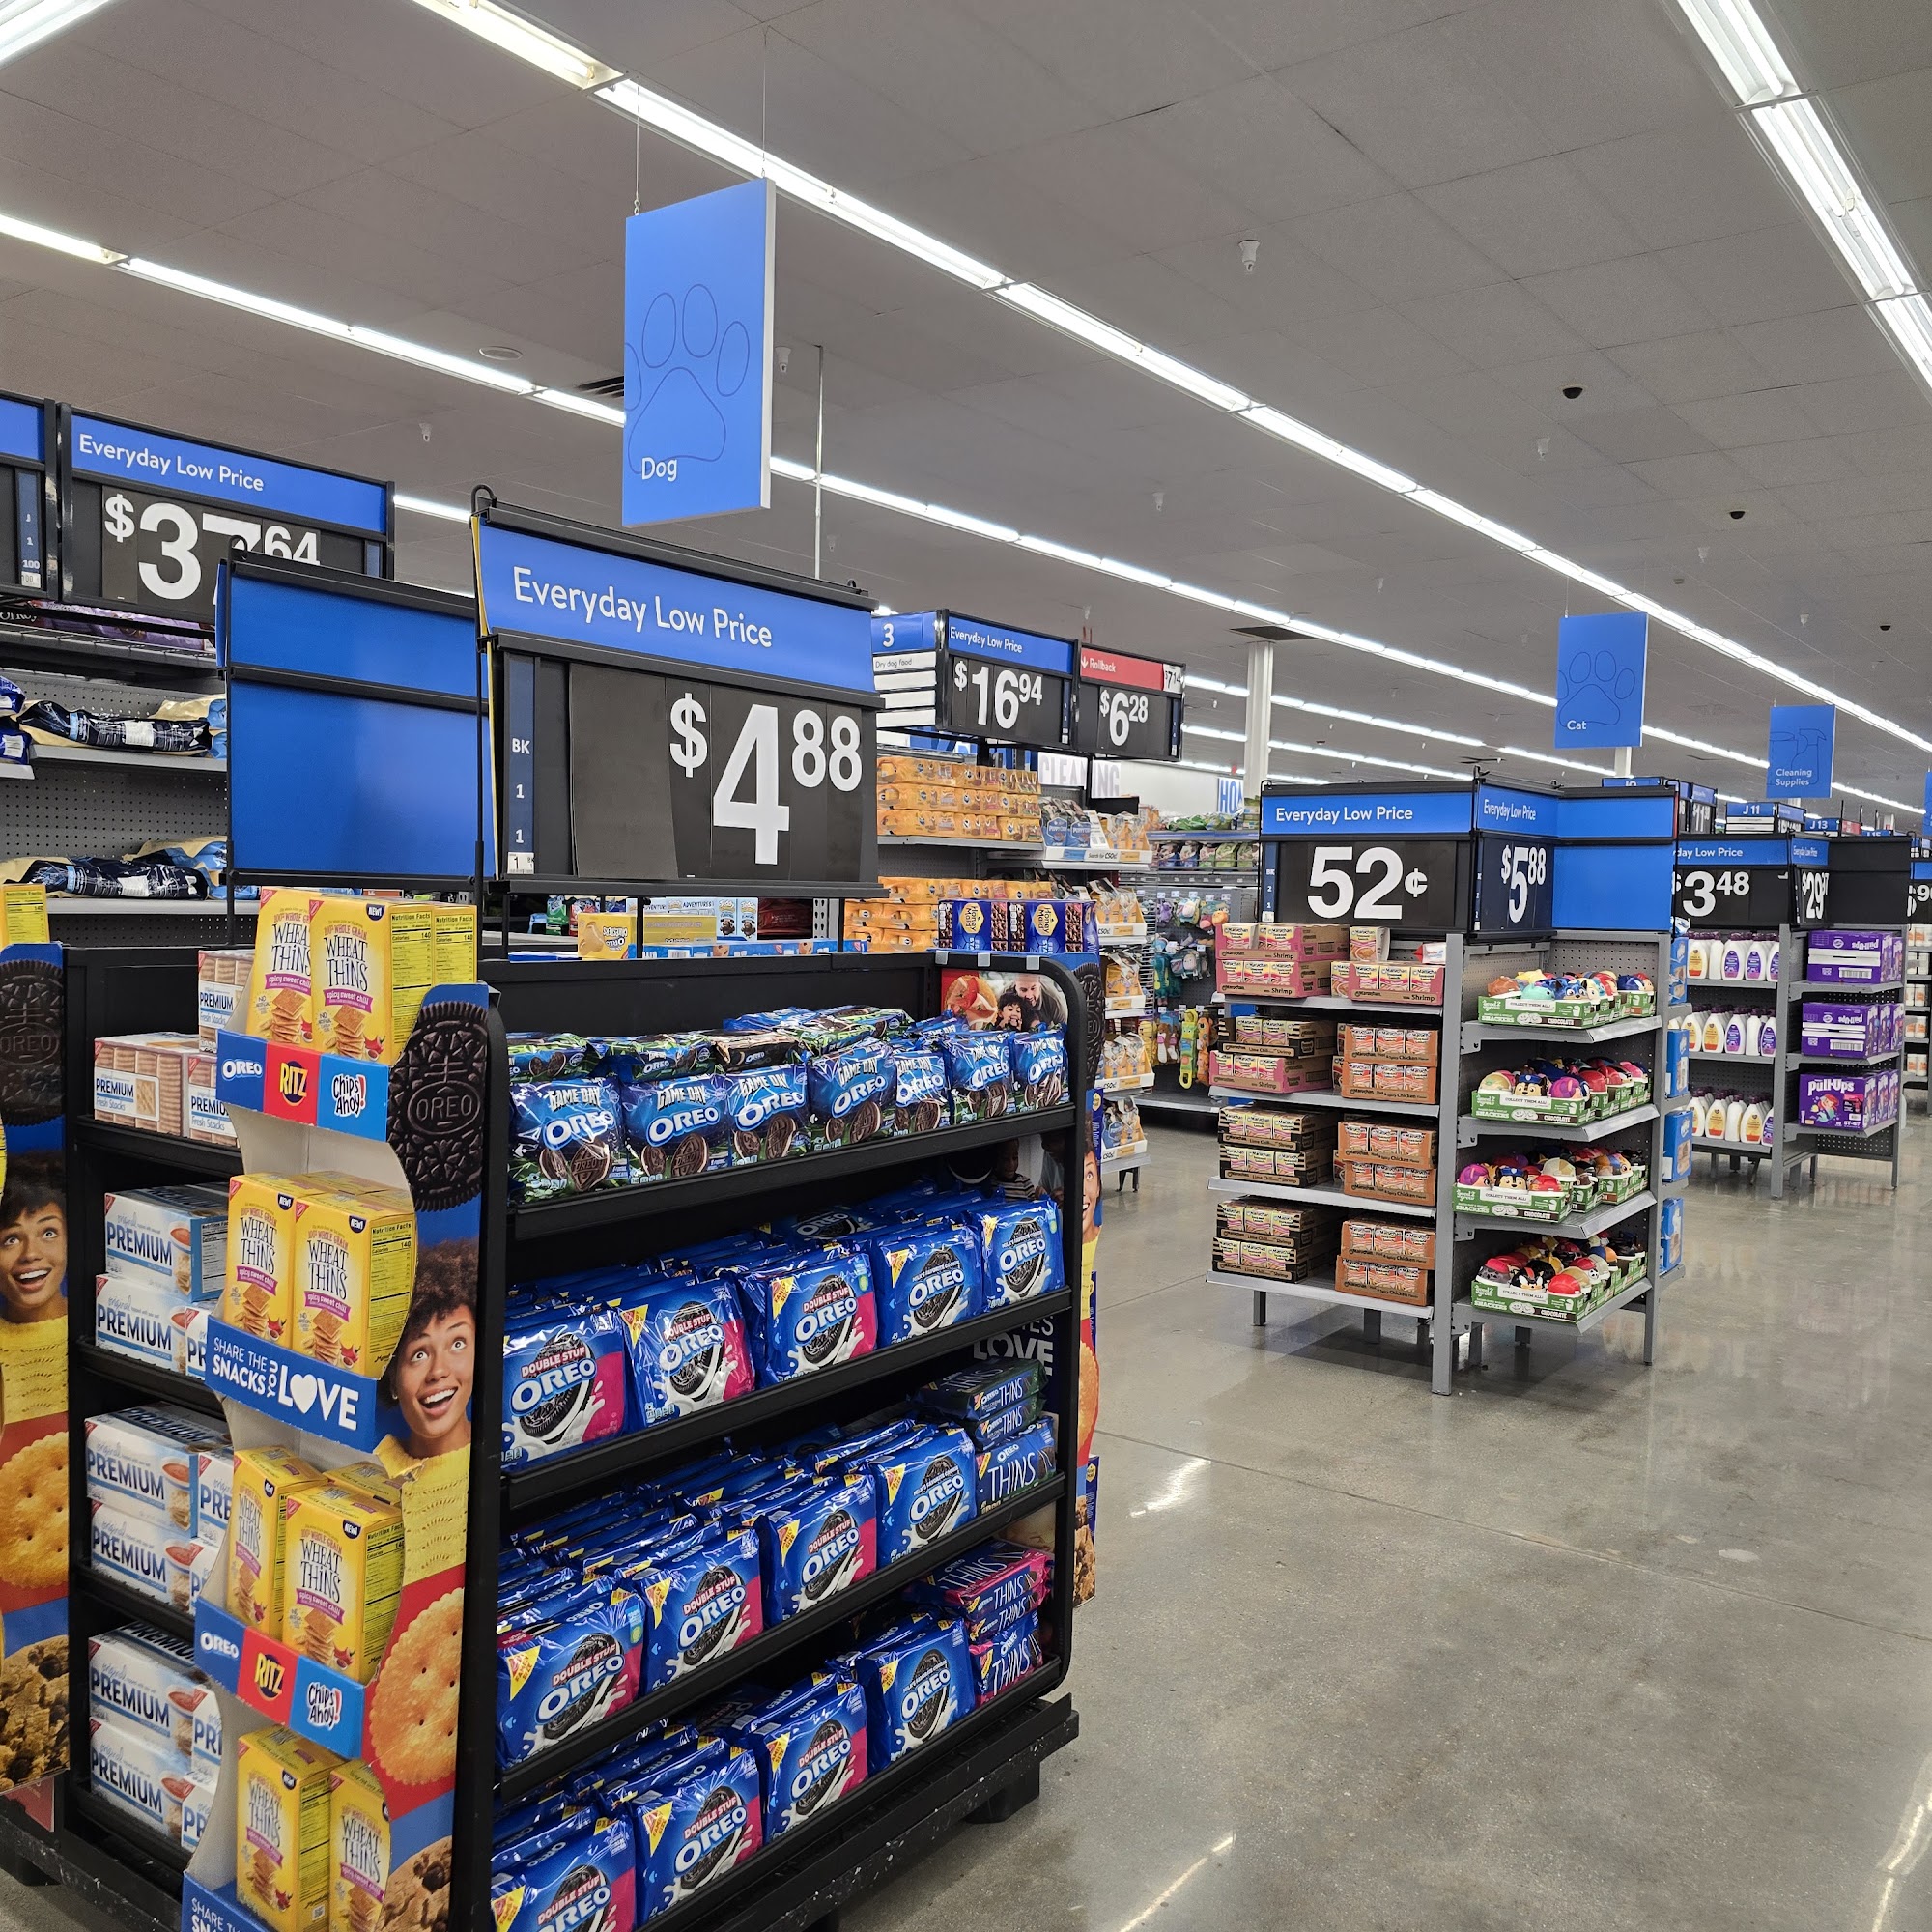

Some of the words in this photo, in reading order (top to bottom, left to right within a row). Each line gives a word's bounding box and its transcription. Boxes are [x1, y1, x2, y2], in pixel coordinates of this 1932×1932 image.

[78, 435, 171, 475] Everyday
[177, 455, 213, 479] Low
[219, 465, 264, 492] Price
[641, 457, 678, 482] Dog
[23, 560, 40, 569] 100
[513, 566, 646, 633] Everyday
[655, 596, 705, 635] Low
[714, 608, 772, 648] Price
[883, 623, 894, 647] 3
[950, 627, 985, 648] Everyday
[987, 637, 1002, 648] Low
[1005, 641, 1022, 653] Price
[1090, 658, 1116, 672] Rollback
[1567, 720, 1586, 730] Cat
[512, 738, 530, 753] BK
[516, 784, 524, 798] 1
[1776, 779, 1809, 787] Supplies
[1276, 808, 1339, 824] Everyday
[1343, 807, 1373, 820] Low
[1376, 806, 1413, 820] Price
[1484, 799, 1510, 821] Everyday
[1511, 804, 1521, 818] Low
[1522, 805, 1536, 820] Price
[516, 829, 524, 843] 1
[1695, 848, 1715, 857] Low
[1719, 848, 1743, 857] Price
[369, 907, 382, 916] NEW!
[272, 922, 309, 947] WHEA
[324, 935, 367, 962] WHEAT
[200, 991, 233, 1010] PREMIUM
[340, 991, 355, 1000] sweet
[222, 1059, 263, 1078] OREO
[280, 1063, 307, 1097] RITZ
[644, 1061, 668, 1073] OREO
[97, 1078, 133, 1097] PREMIUM
[333, 1074, 359, 1099] Chips
[657, 1088, 686, 1110] GAME
[110, 1099, 125, 1111] Stacks
[416, 1095, 473, 1121] OREO
[548, 1090, 578, 1112] GAME
[581, 1088, 600, 1106] DAY
[207, 1119, 224, 1130] Stacks
[241, 1217, 277, 1247] WHEAT
[373, 1225, 395, 1234] Nutrition
[107, 1221, 172, 1265] PREMIUM
[307, 1240, 349, 1271] WHEAT
[1000, 1240, 1045, 1271] OREO
[308, 1293, 319, 1303] spicy
[321, 1295, 335, 1306] sweet
[804, 1295, 831, 1312] DOUBLE
[833, 1288, 849, 1301] STUF
[910, 1269, 964, 1306] OREO
[98, 1304, 172, 1350] PREMIUM
[665, 1321, 692, 1340] DOUBLE
[692, 1314, 711, 1327] STUF
[796, 1298, 856, 1340] OREO
[213, 1337, 244, 1362] SHARE
[248, 1350, 268, 1372] THE
[522, 1354, 561, 1378] DOUBLE
[562, 1347, 586, 1363] STUF
[213, 1354, 265, 1395] SNACKS
[267, 1361, 278, 1398] YOU
[512, 1360, 596, 1410] OREO
[999, 1378, 1022, 1406] THINS
[1003, 1406, 1022, 1435] THINS
[988, 1453, 1036, 1501] THINS
[910, 1475, 964, 1520] OREO
[803, 1528, 859, 1582] OREO
[680, 1586, 746, 1646] OREO
[200, 1632, 240, 1659] OREO
[255, 1652, 285, 1696] RITZ
[308, 1683, 334, 1709] Chips
[539, 1658, 624, 1719] OREO
[902, 1669, 951, 1719] OREO
[791, 1738, 851, 1798] OREO
[675, 1805, 747, 1873] OREO
[191, 1897, 223, 1929] SHARE
